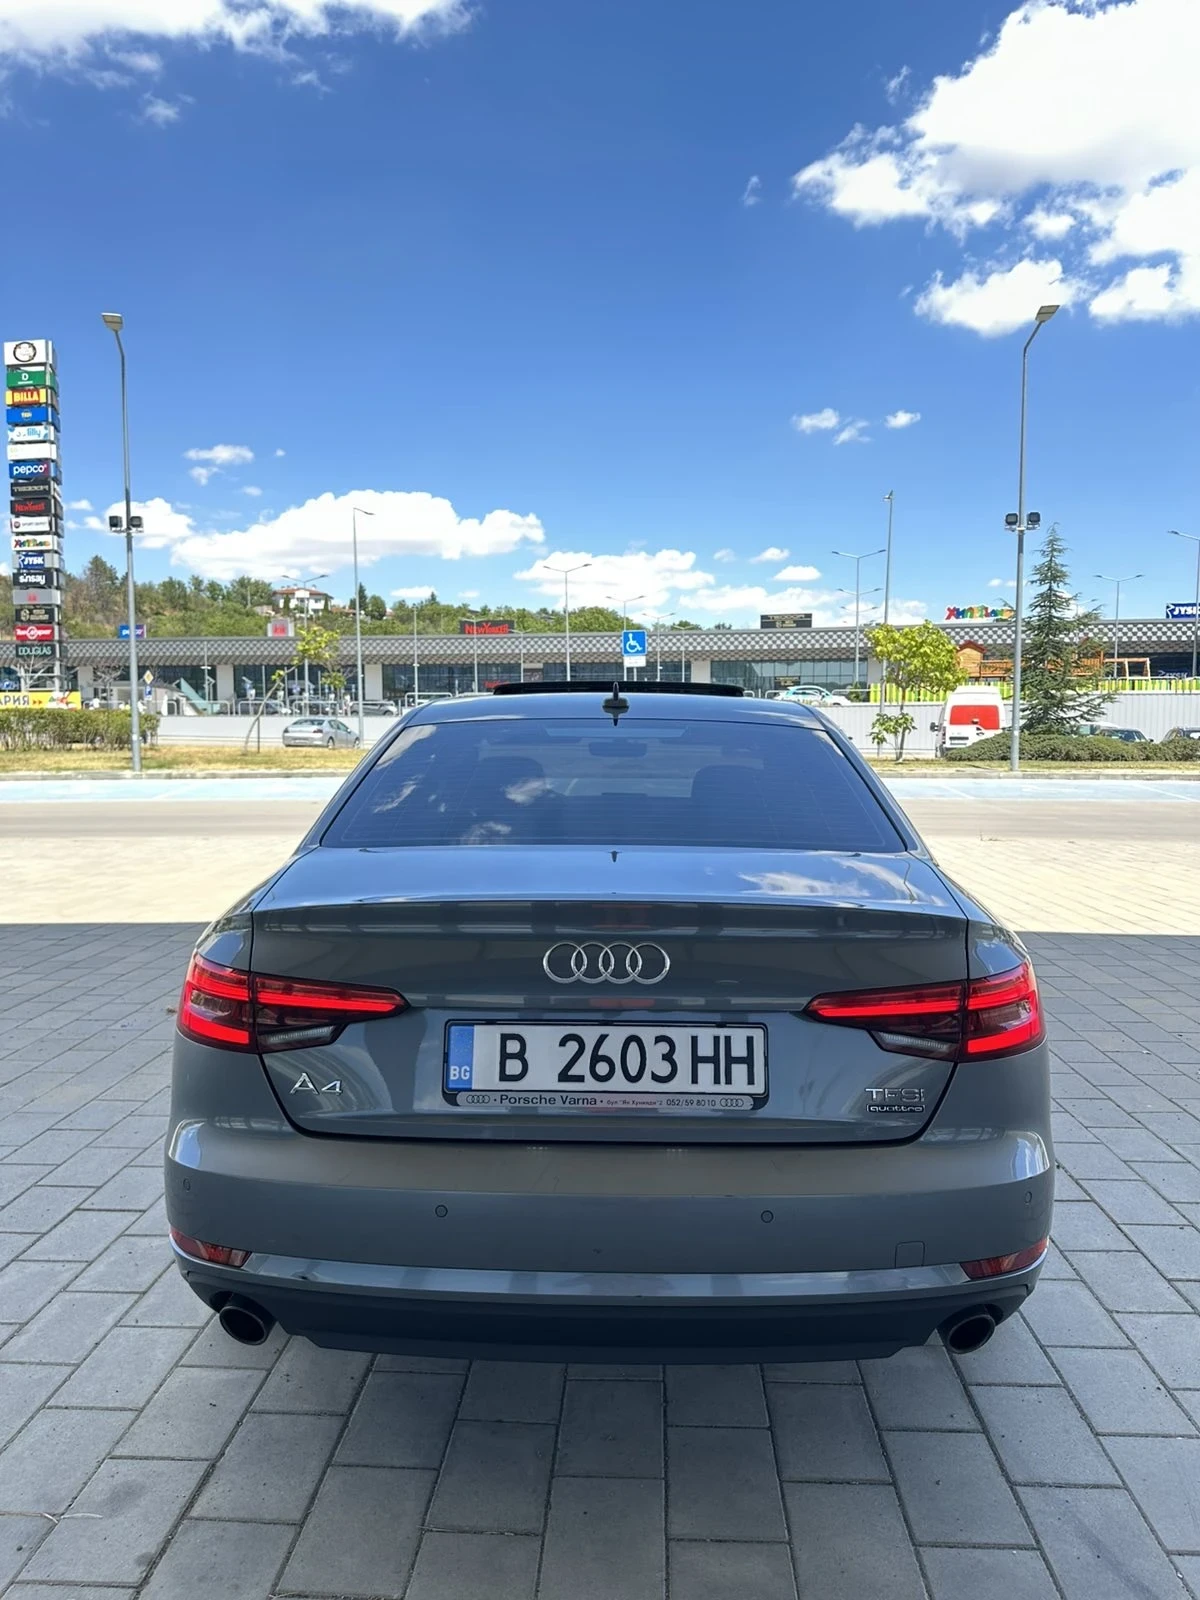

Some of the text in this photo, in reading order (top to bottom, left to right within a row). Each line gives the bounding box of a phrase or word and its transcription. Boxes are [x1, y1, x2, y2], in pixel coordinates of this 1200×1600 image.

[13, 391, 39, 402] BILLA
[13, 465, 45, 475] pepco
[24, 557, 44, 565] JYSK
[19, 574, 46, 585] sinsay
[18, 646, 52, 655] DOUGLAS
[498, 1033, 755, 1086] B 2603 HH
[449, 1066, 471, 1081] BG
[289, 1072, 343, 1096] A4
[500, 1094, 556, 1105] Porsche
[559, 1094, 597, 1106] Varna
